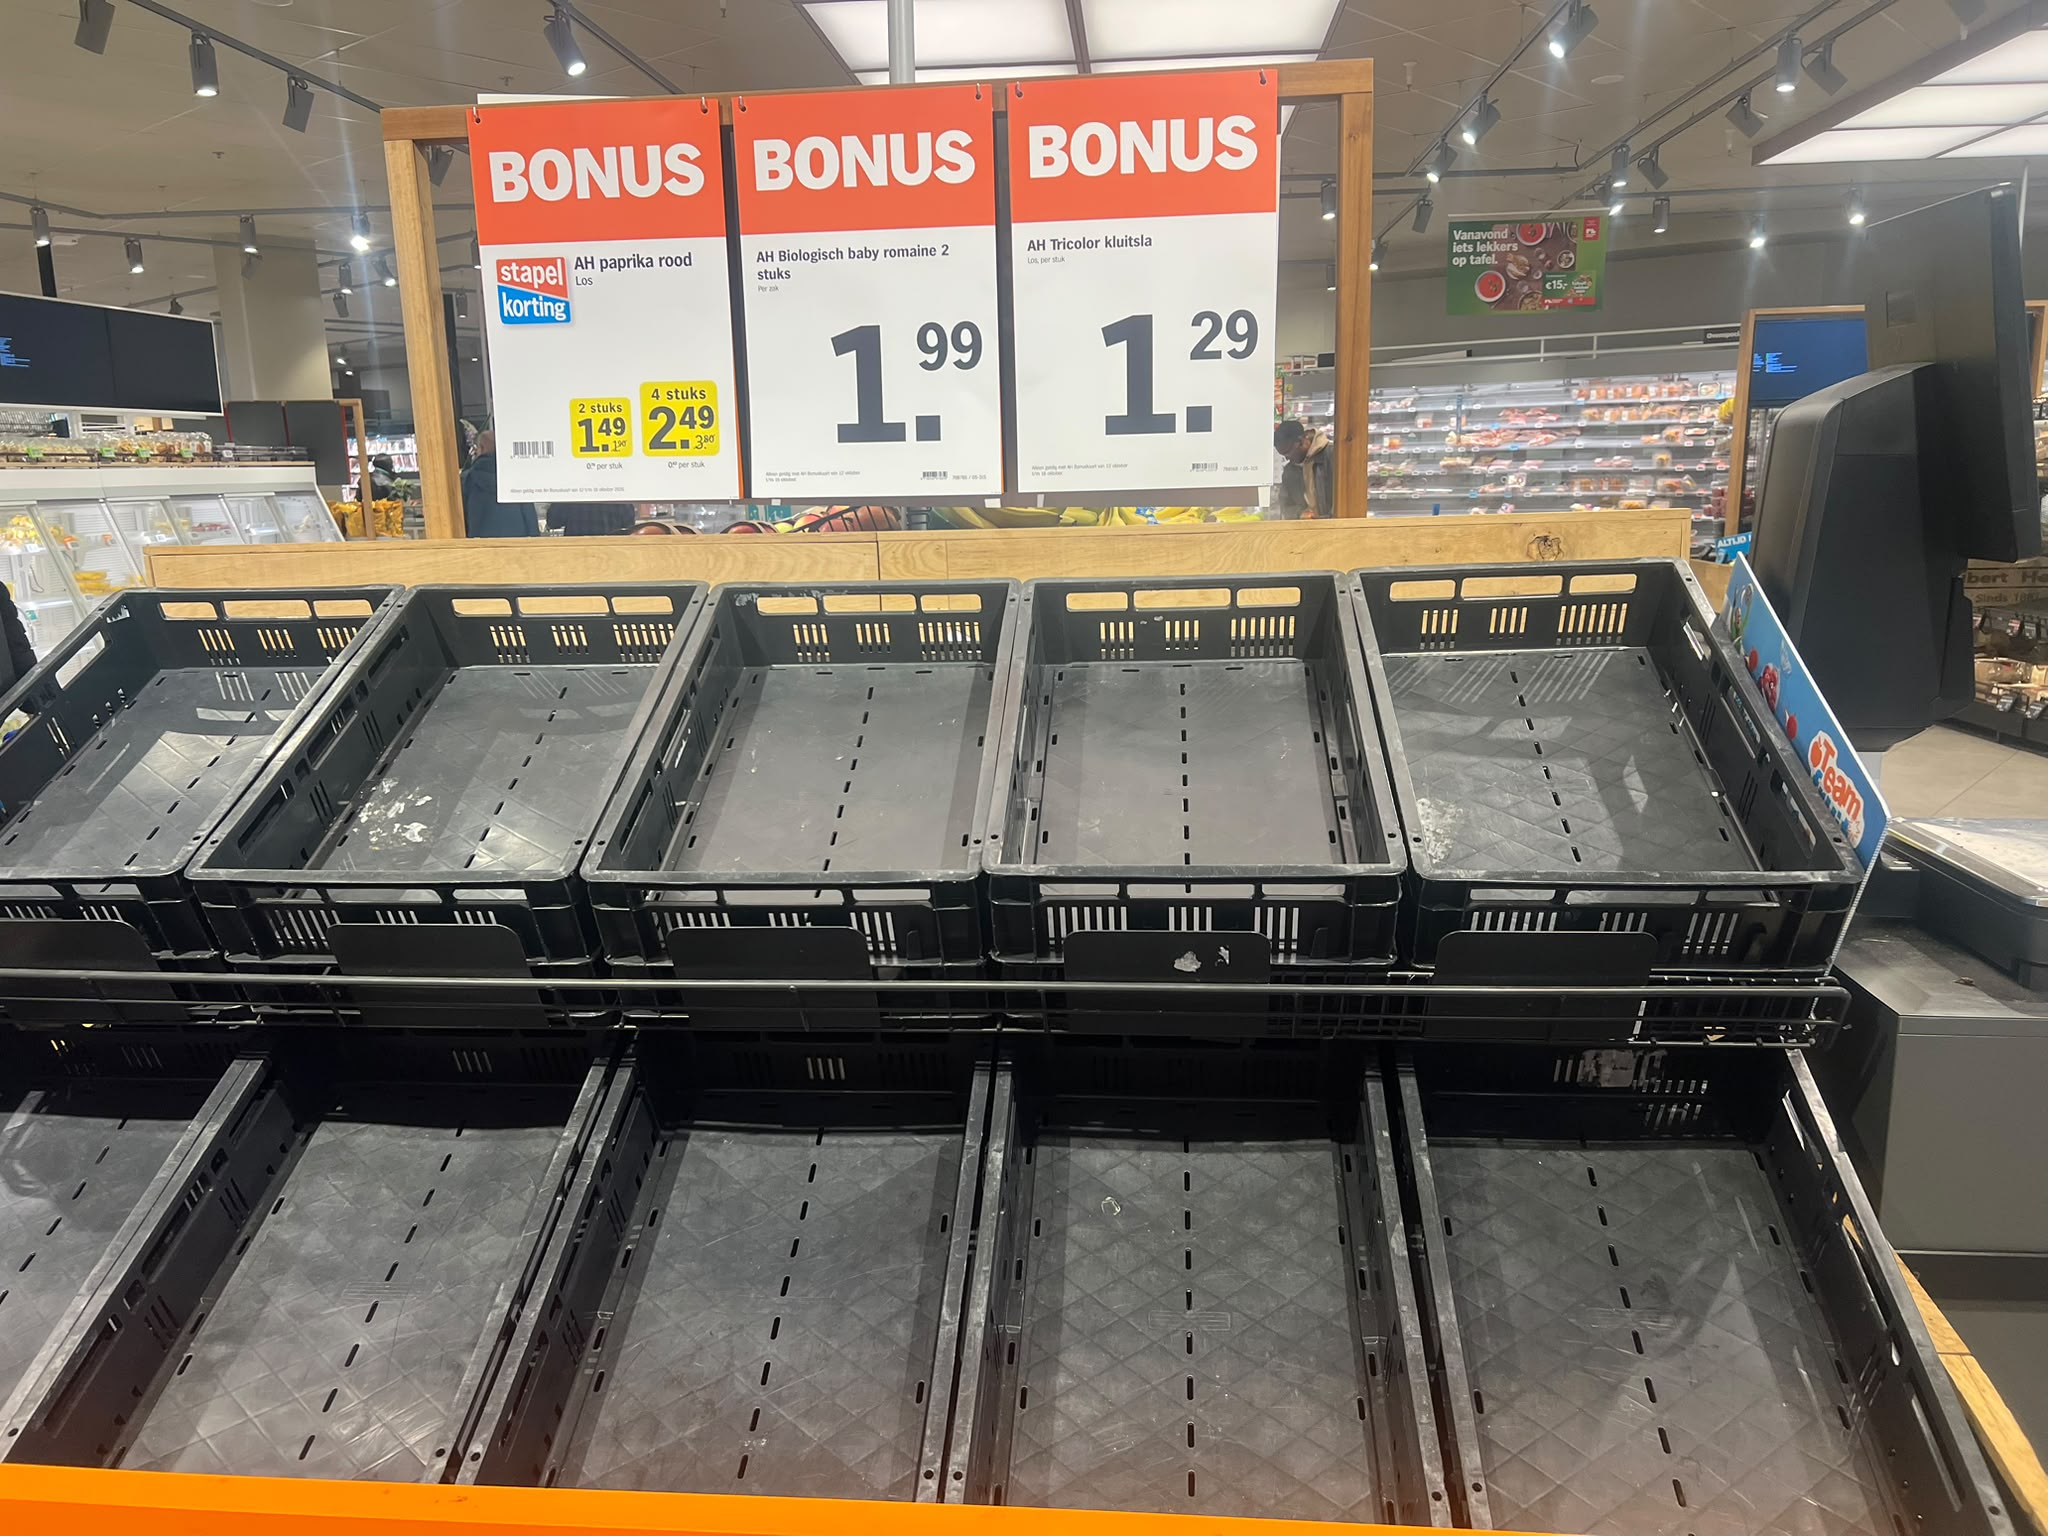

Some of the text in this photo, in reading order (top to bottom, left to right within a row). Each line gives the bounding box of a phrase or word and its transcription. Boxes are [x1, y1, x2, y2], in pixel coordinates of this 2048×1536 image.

[1028, 115, 1258, 179] BONUS
[753, 129, 976, 191] BONUS
[488, 142, 705, 203] BONUS
[1453, 228, 1508, 240] Vanavond
[1027, 234, 1152, 251] AH Tricolor kluitsla
[1452, 241, 1518, 253] iets lekkers
[757, 244, 950, 263] AH Biologisch baby romaine 2
[1452, 253, 1498, 267] op tafel.
[574, 252, 692, 272] AH paprika rood
[501, 258, 563, 289] stapel
[575, 276, 593, 286] Los
[757, 267, 791, 280] stuks
[502, 292, 566, 321] korting
[651, 386, 706, 400] 4 stuks
[578, 402, 623, 413] 2 stuks
[1717, 536, 1746, 548] ALTIJD
[1966, 570, 2048, 583] bert He
[1820, 738, 1861, 821] Team
